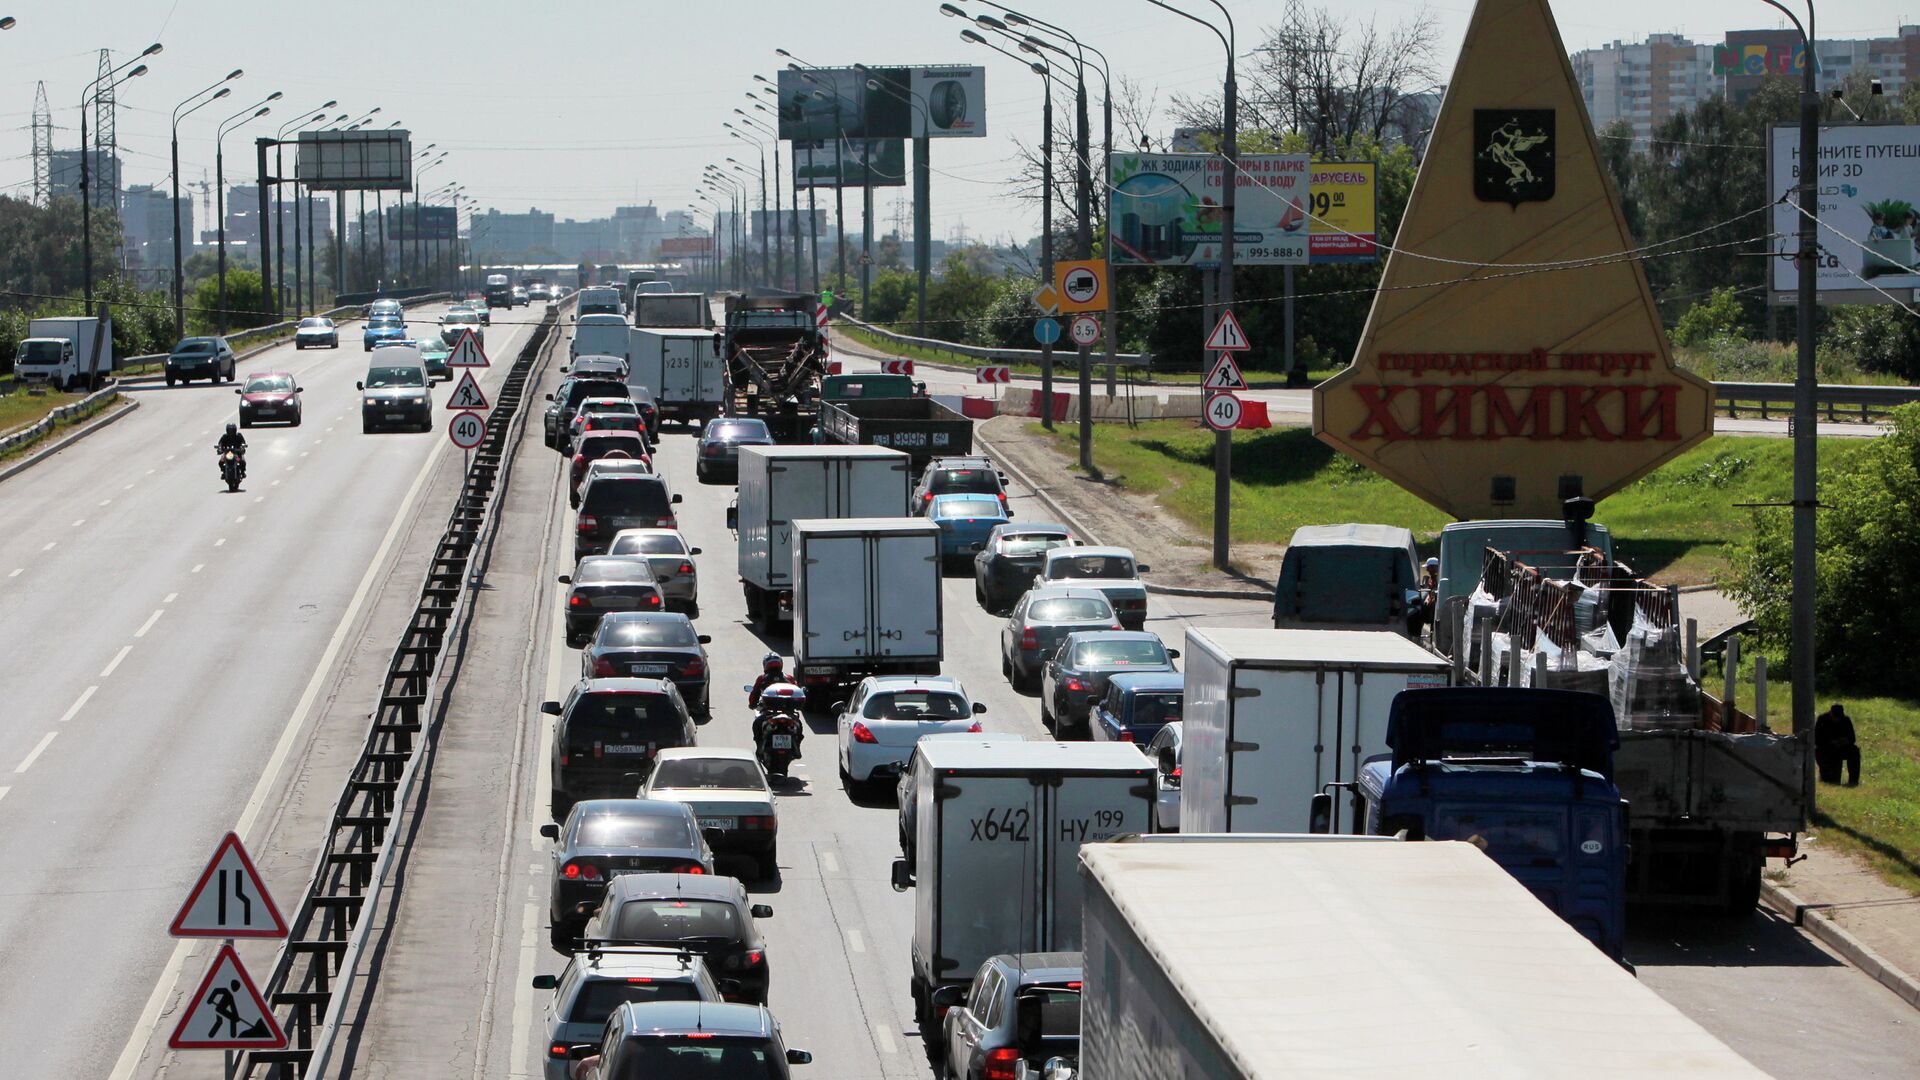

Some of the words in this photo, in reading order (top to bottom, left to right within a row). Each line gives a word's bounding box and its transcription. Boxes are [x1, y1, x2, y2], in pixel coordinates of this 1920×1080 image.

[1792, 146, 1862, 159] ННИТЕ
[1141, 160, 1158, 171] ЖК
[1161, 160, 1202, 173] ЗОДИАК
[1207, 160, 1262, 172] КВИРЫ
[1264, 161, 1270, 171] В
[1274, 161, 1305, 172] ПАРКЕ
[1843, 165, 1863, 177] 3D
[1207, 176, 1213, 186] С
[1215, 176, 1252, 188] ВОМ
[1270, 176, 1296, 188] ВОДУ
[1333, 192, 1345, 202] 00
[1250, 248, 1303, 258] 995-888-0
[1818, 254, 1839, 268] LG
[1378, 347, 1549, 378] городской
[1560, 352, 1656, 378] округ
[1213, 402, 1233, 419] 40
[1349, 384, 1683, 442] ХИМКИ
[457, 421, 477, 438] 40
[1094, 810, 1124, 828] 199
